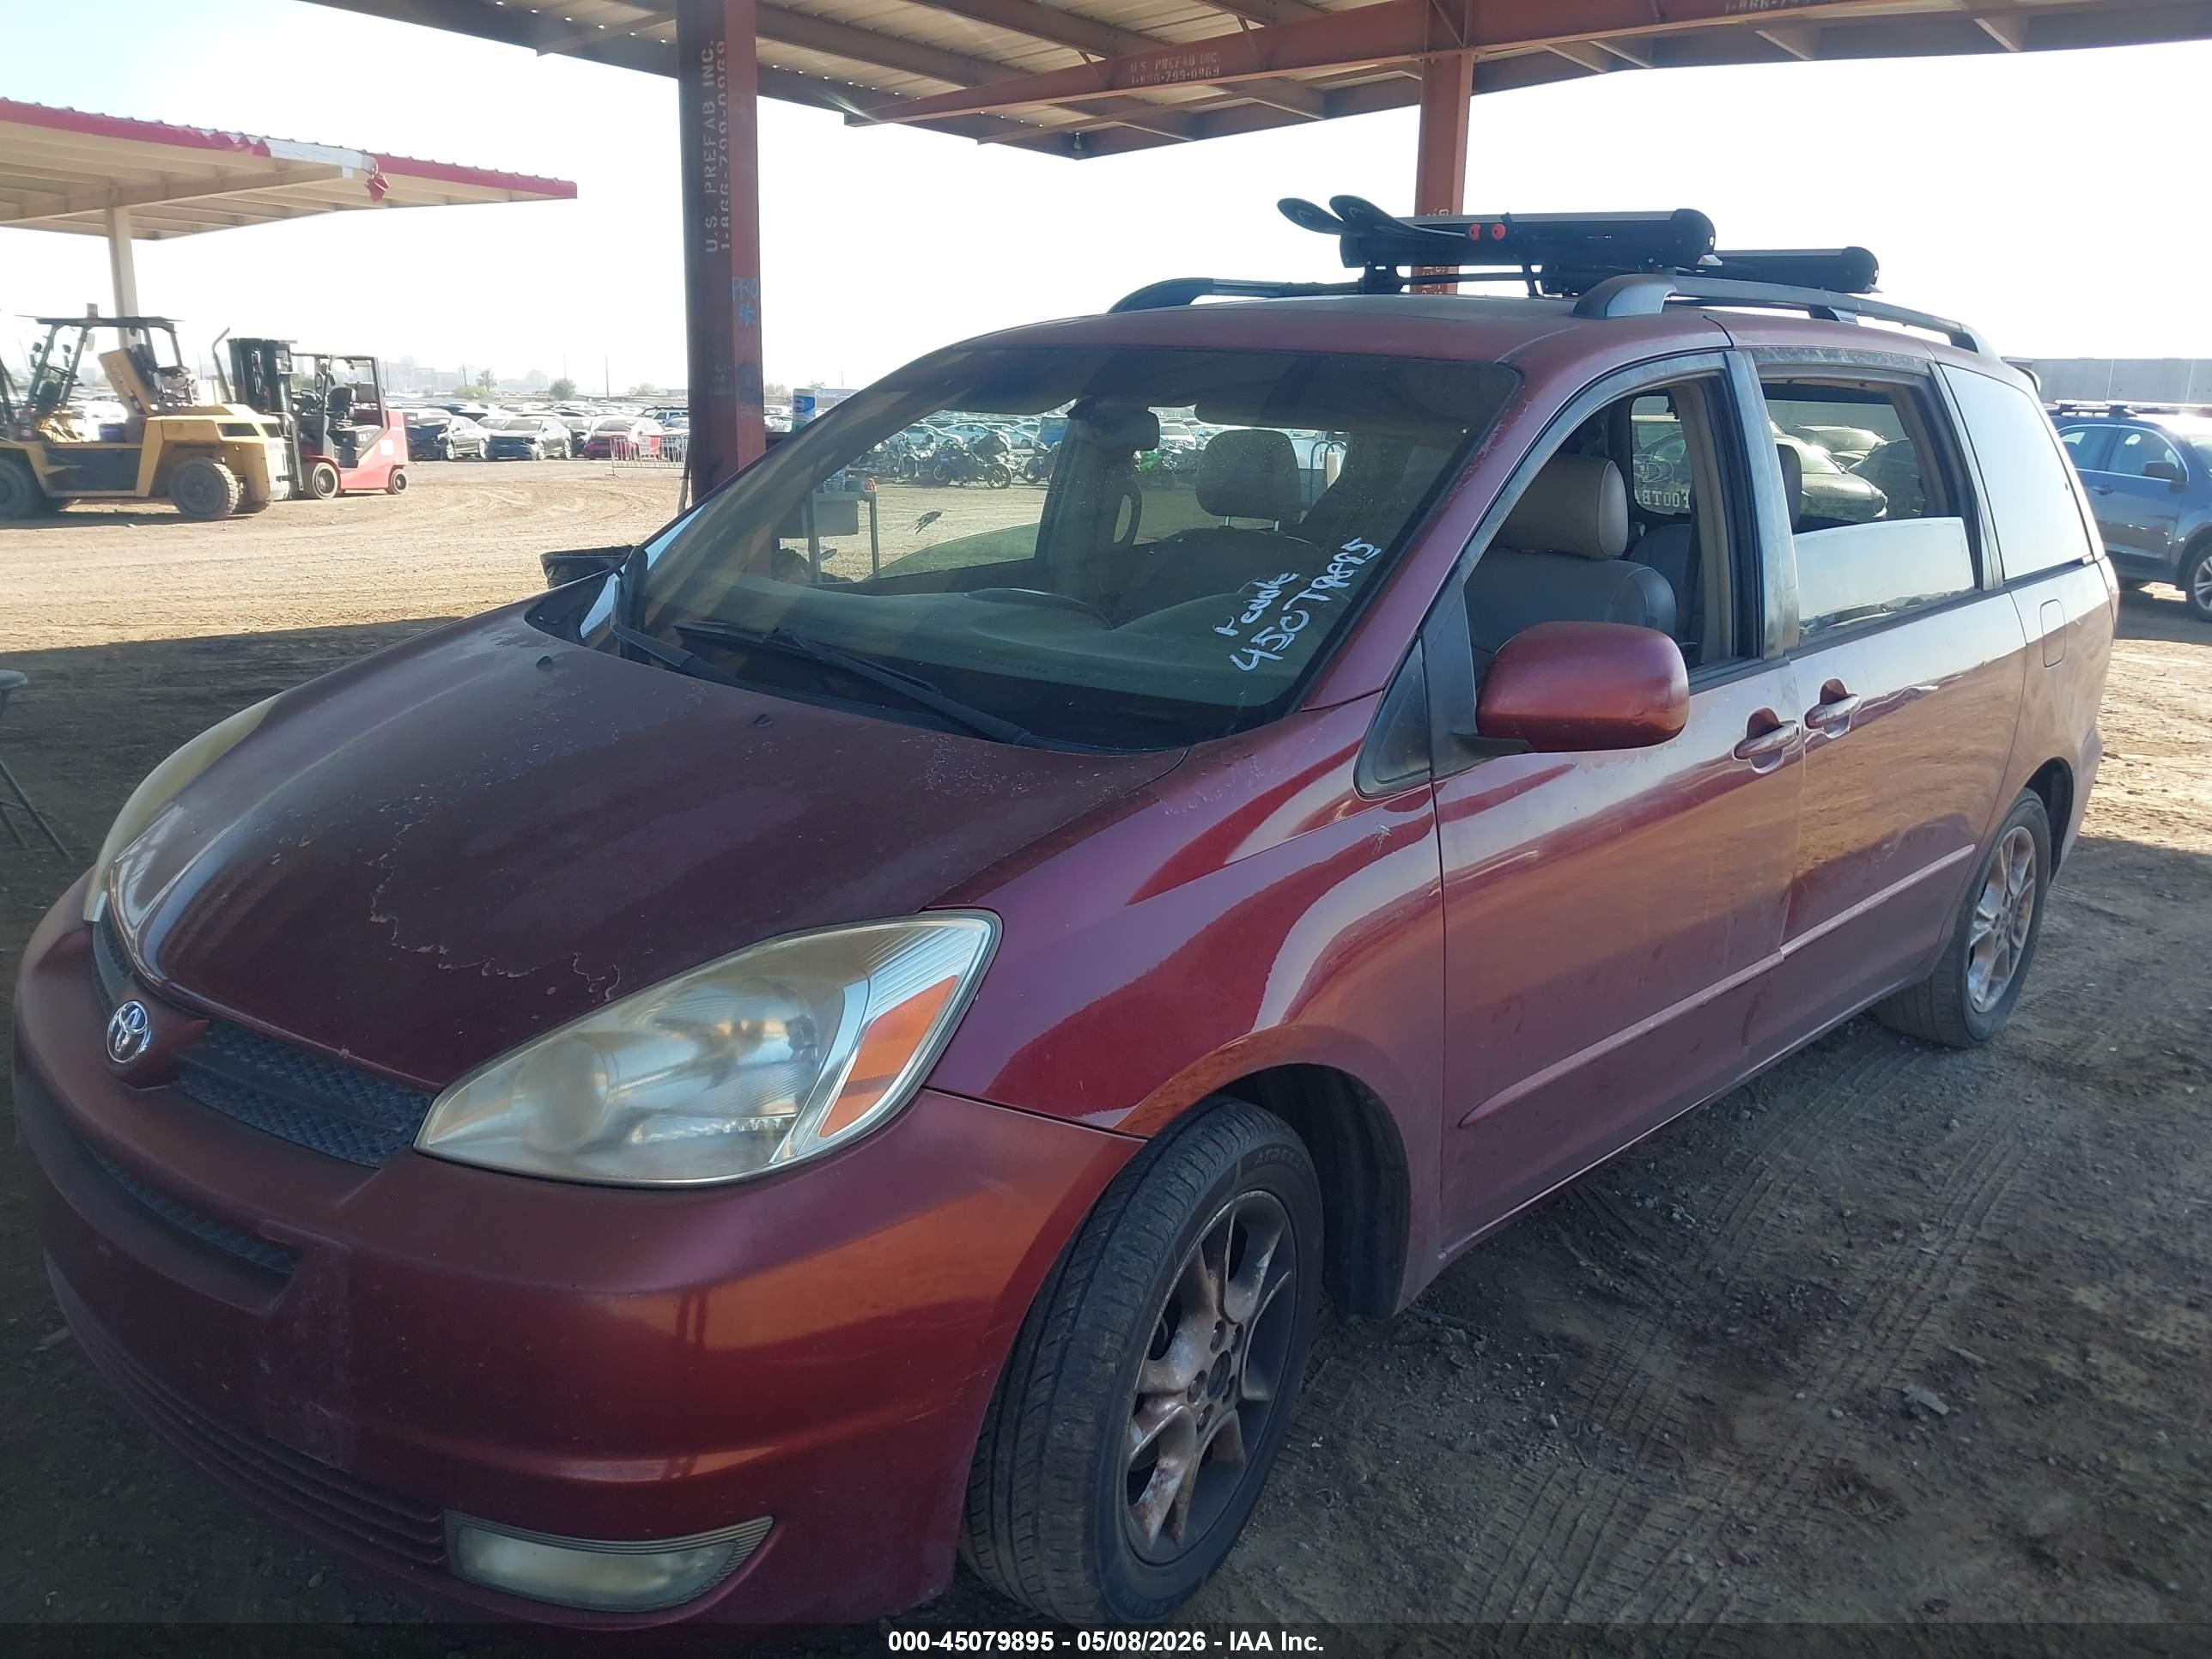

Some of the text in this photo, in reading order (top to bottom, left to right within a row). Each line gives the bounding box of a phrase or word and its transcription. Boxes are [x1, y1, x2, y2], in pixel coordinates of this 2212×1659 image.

[701, 40, 715, 87] INC.
[1155, 55, 1195, 70] PREFAB
[701, 100, 717, 193] PREFAB
